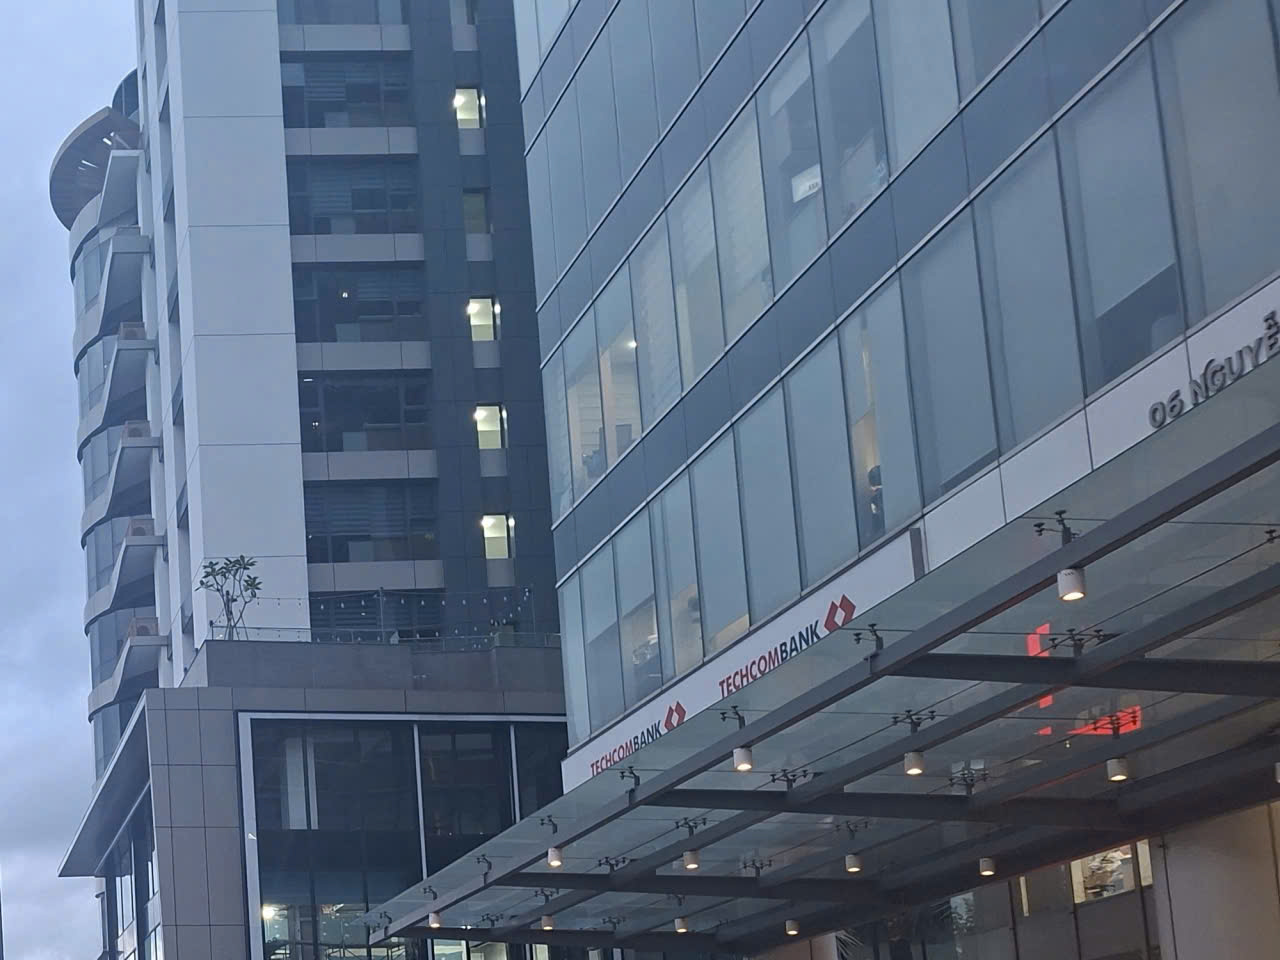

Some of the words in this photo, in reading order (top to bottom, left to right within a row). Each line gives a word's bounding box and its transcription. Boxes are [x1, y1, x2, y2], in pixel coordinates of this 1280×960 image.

[1149, 389, 1184, 428] 06
[719, 620, 821, 698] TECHCOMBANK
[591, 720, 662, 777] TECHCOMBANK
